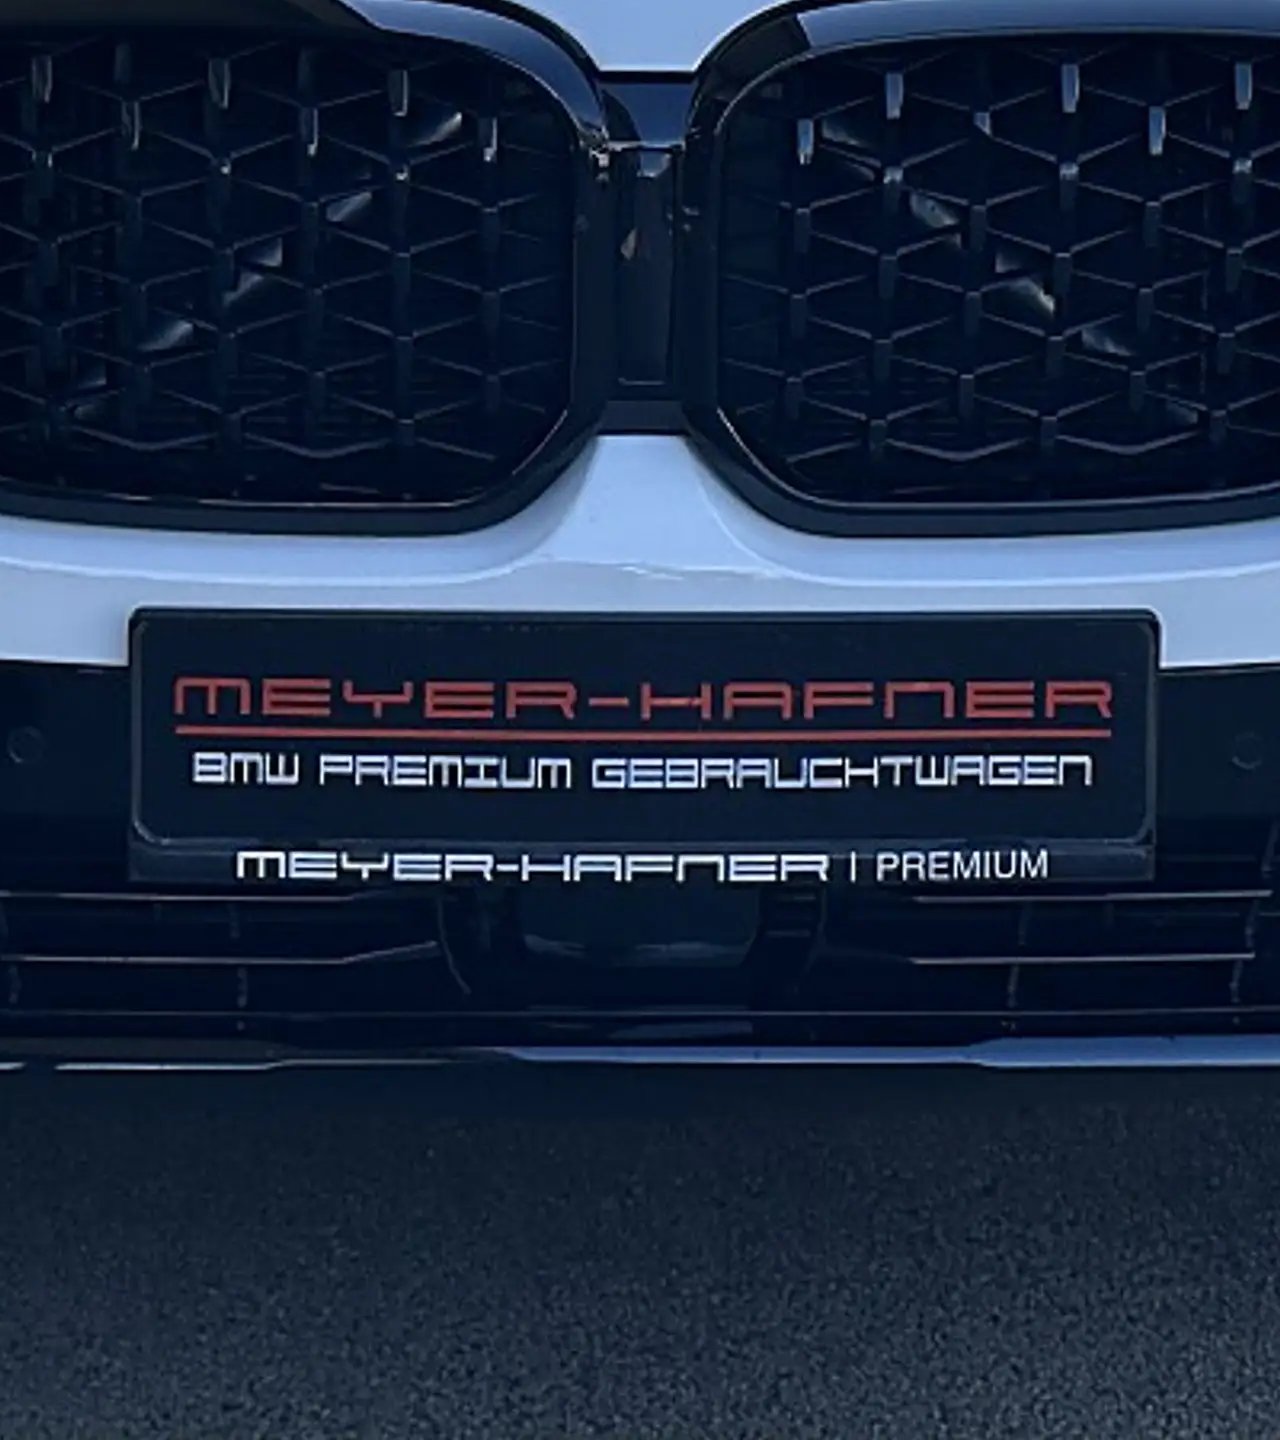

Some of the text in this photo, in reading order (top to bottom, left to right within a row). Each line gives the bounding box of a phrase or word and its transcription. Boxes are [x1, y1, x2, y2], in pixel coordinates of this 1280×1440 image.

[174, 676, 1114, 720] MEYER-HAFNER
[192, 751, 1094, 790] BMW PREMIUM GEBRAUCHTWAGEN
[236, 847, 1050, 883] MEYER-HAFNER PREMIUM
